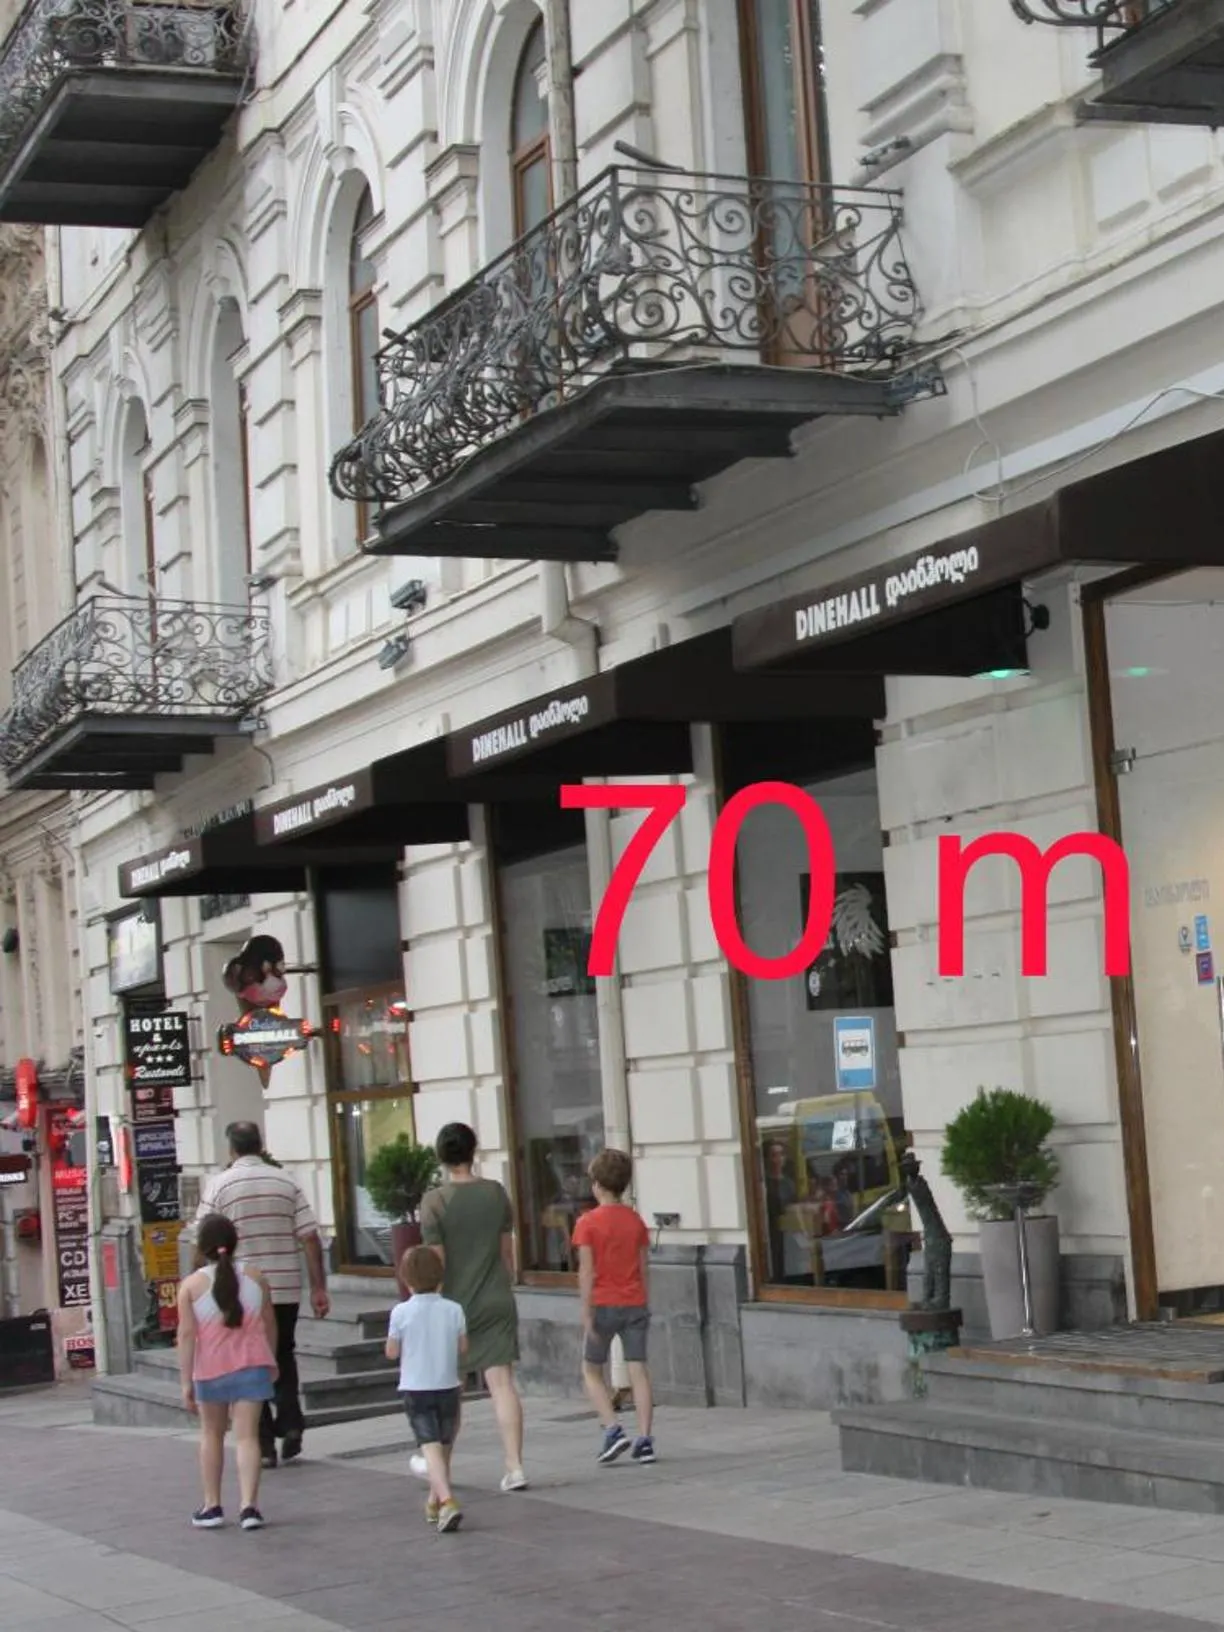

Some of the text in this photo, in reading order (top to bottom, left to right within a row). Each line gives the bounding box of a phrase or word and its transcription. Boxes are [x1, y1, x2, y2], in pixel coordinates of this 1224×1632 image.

[795, 583, 880, 640] DINEHALL
[472, 718, 527, 763] DINEHALL
[130, 1016, 183, 1032] HOTEL
[60, 1250, 86, 1267] CD
